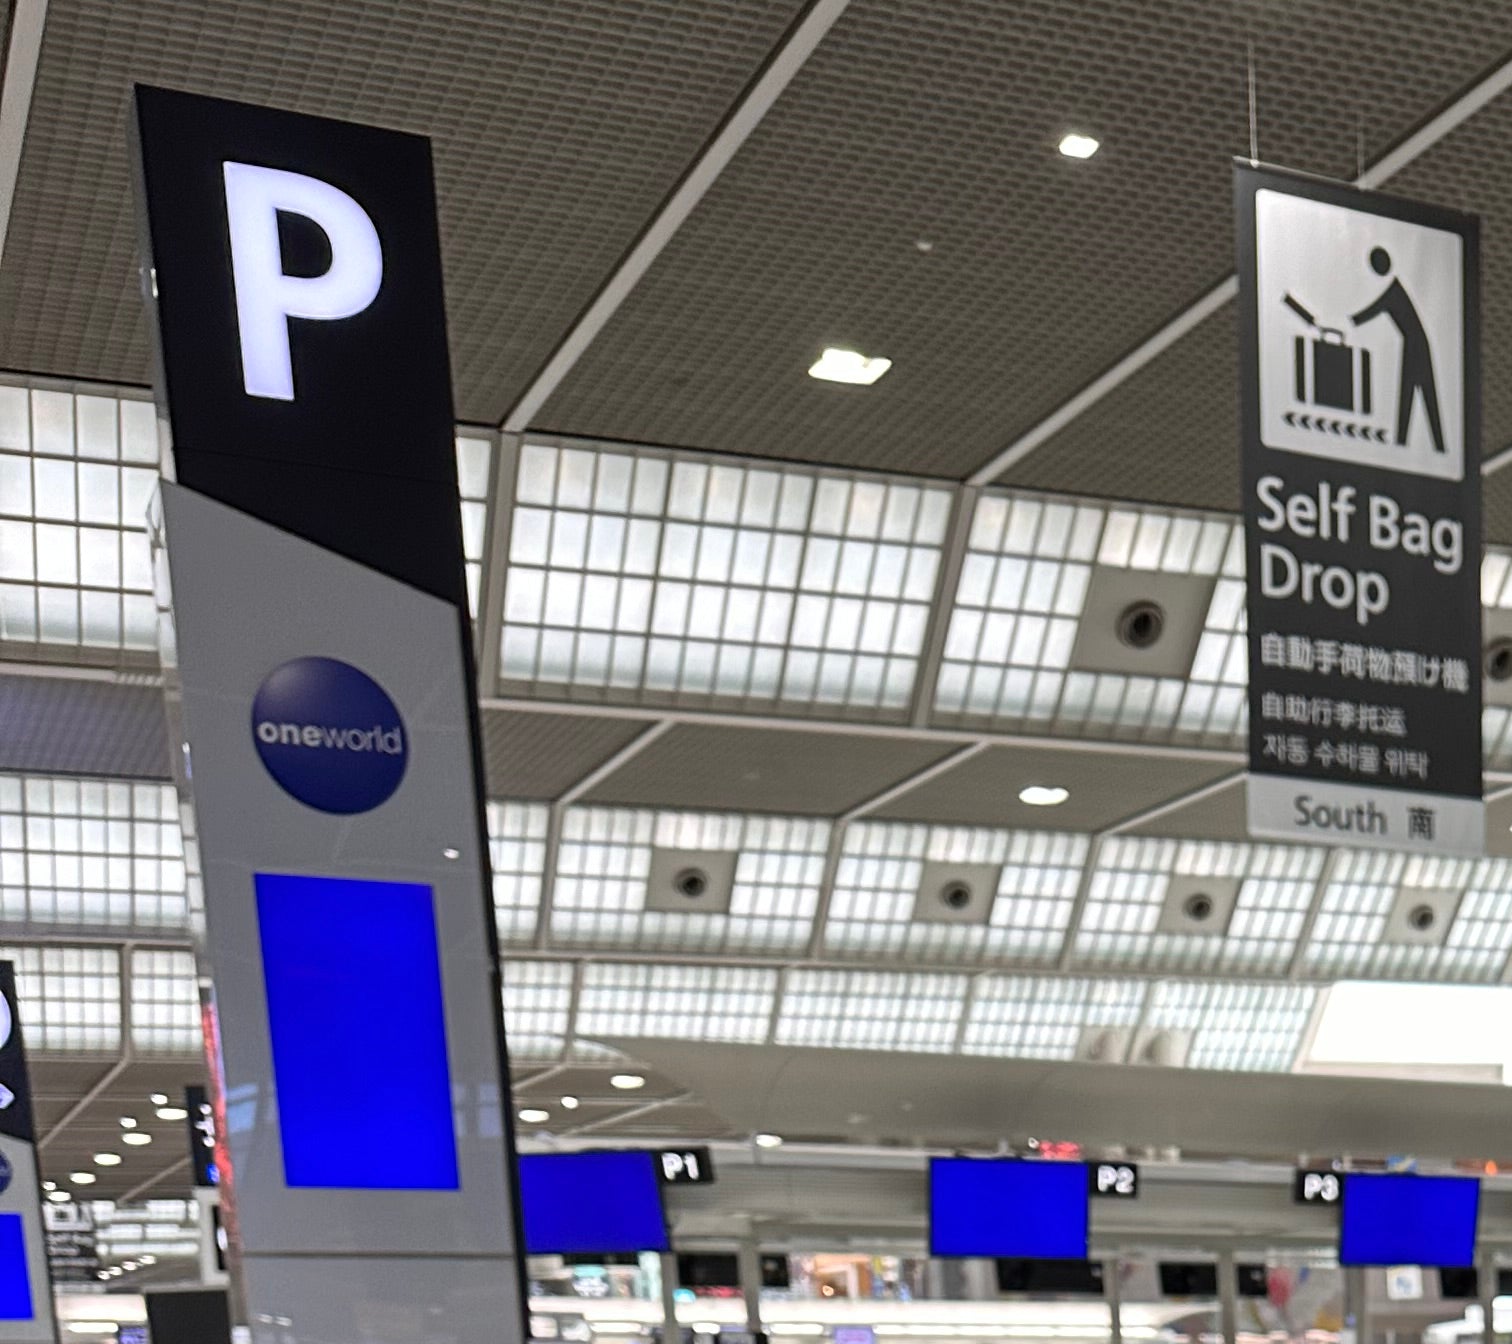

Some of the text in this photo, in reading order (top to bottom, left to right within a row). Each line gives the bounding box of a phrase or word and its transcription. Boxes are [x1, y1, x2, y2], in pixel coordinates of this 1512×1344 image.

[222, 160, 383, 401] P
[1256, 476, 1463, 575] Self Bag
[1260, 542, 1390, 626] Drop
[1260, 632, 1469, 694] 自動手荷物預け機
[1261, 691, 1407, 738] 自助行李托运
[257, 721, 402, 755] oneworld
[1294, 794, 1387, 835] South
[1407, 806, 1435, 841] 南
[661, 1152, 699, 1180] P1
[1097, 1165, 1135, 1194] P2
[1304, 1173, 1339, 1201] P3
